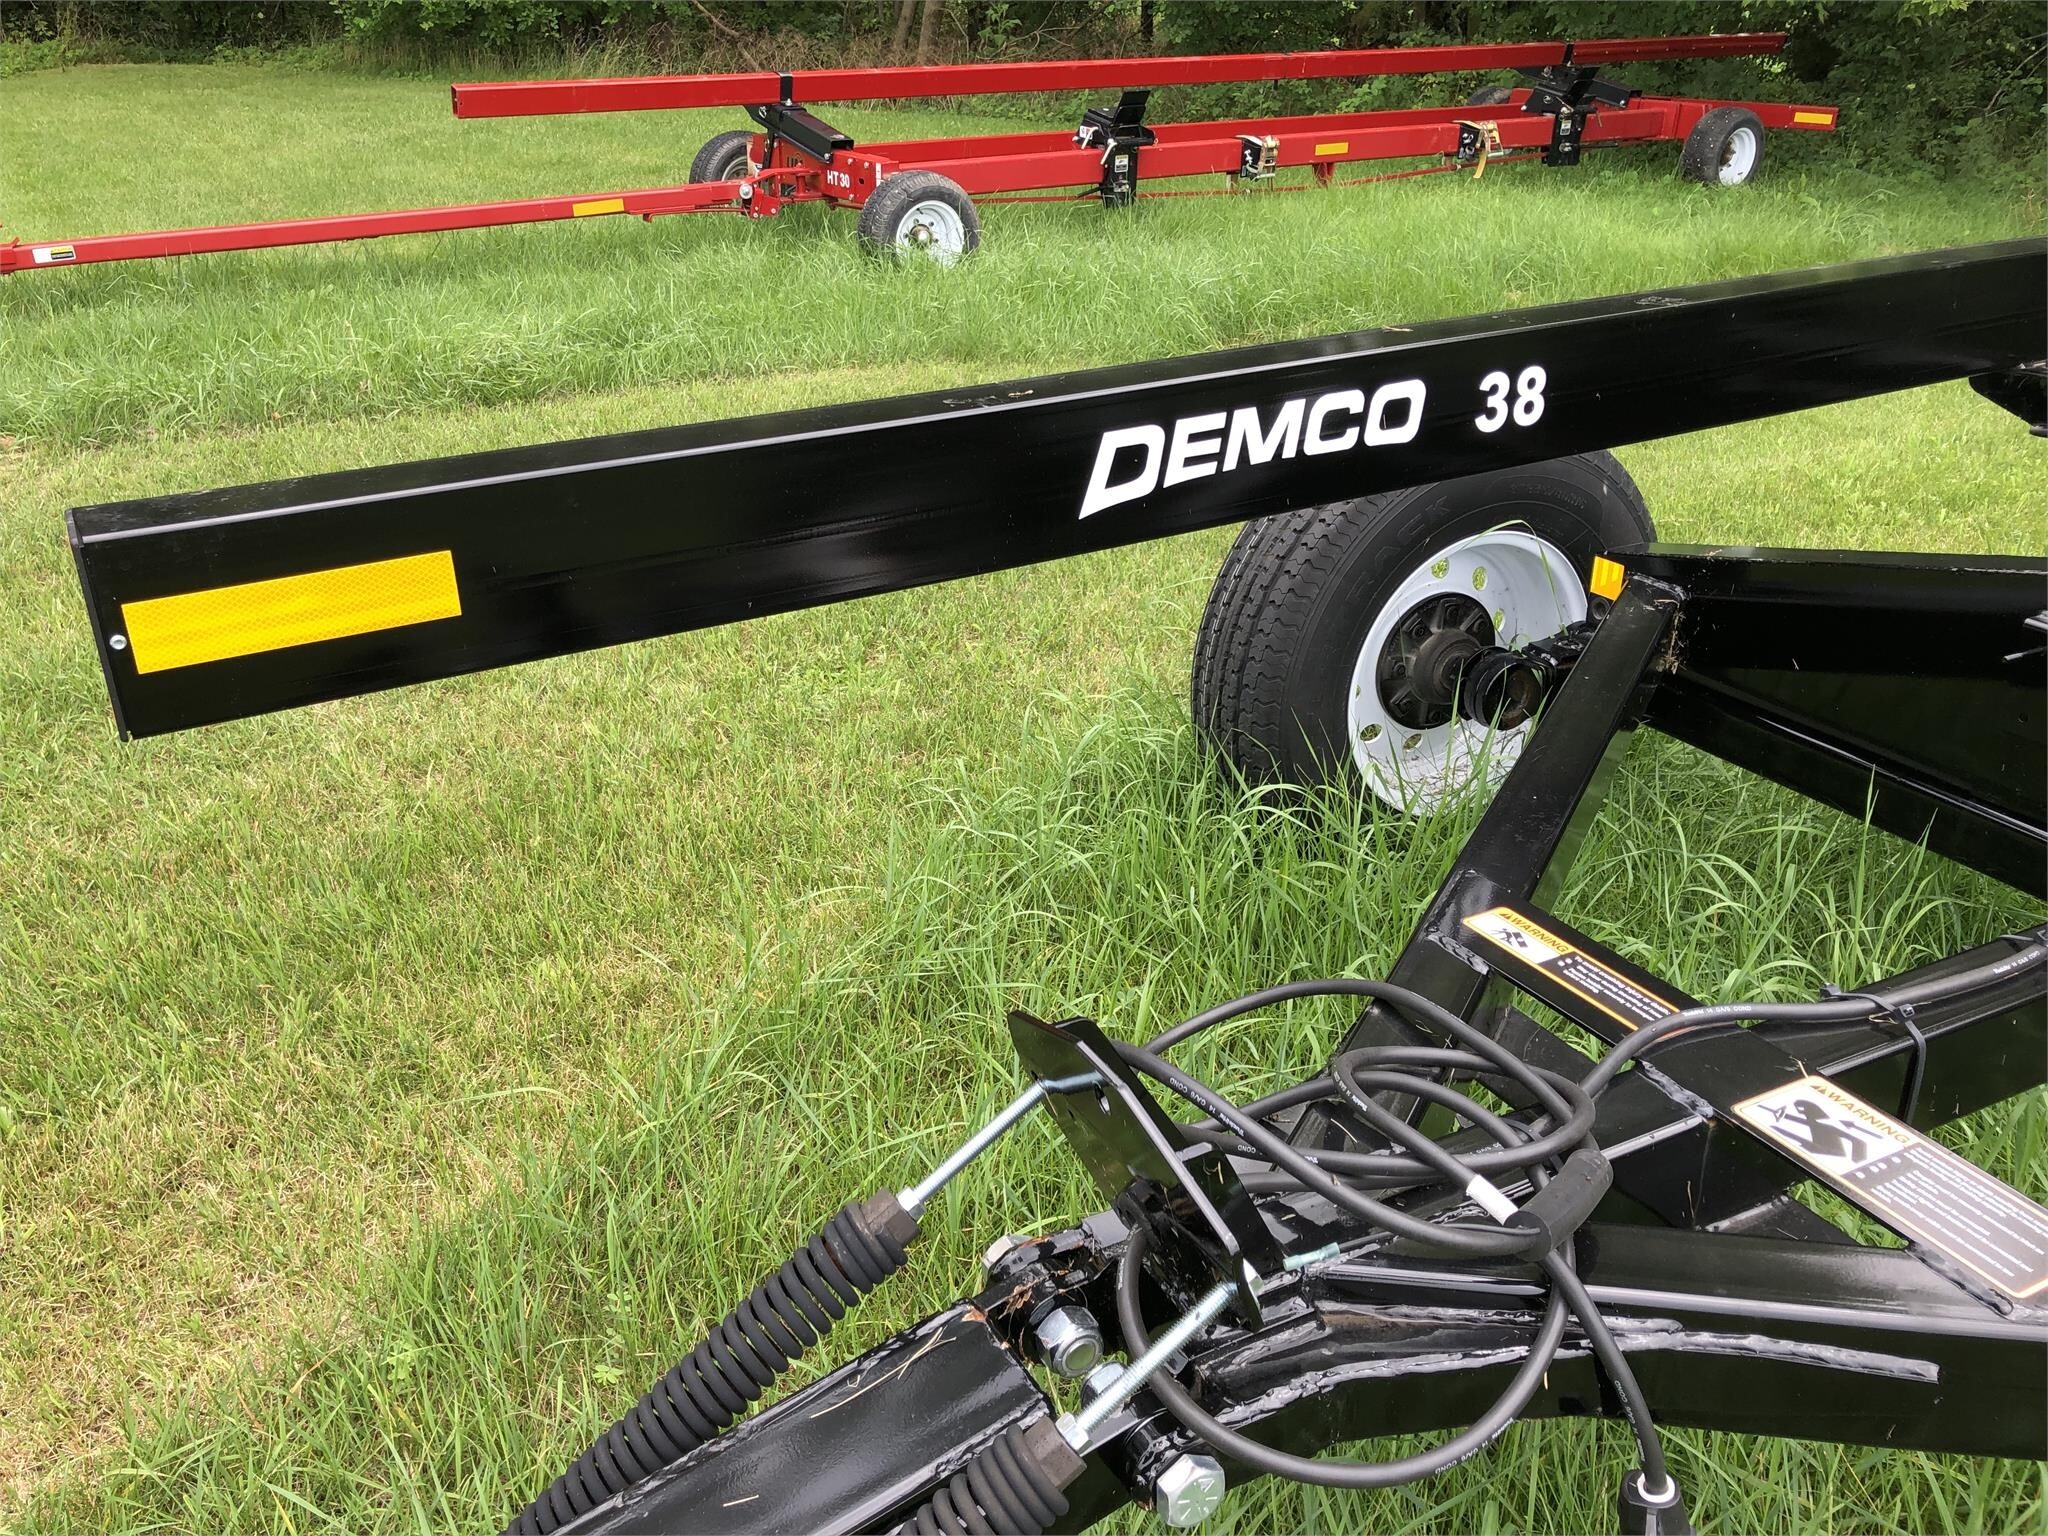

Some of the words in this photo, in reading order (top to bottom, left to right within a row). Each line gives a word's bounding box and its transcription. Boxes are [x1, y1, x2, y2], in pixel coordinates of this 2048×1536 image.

[827, 169, 839, 186] HT
[840, 172, 850, 189] 30
[1078, 378, 1427, 520] DEMCO
[1474, 365, 1547, 434] 38
[1510, 915, 1569, 953] WARNING
[1169, 1077, 1188, 1094] COND
[1827, 1091, 1911, 1144] WARNING
[1237, 1144, 1257, 1154] COND
